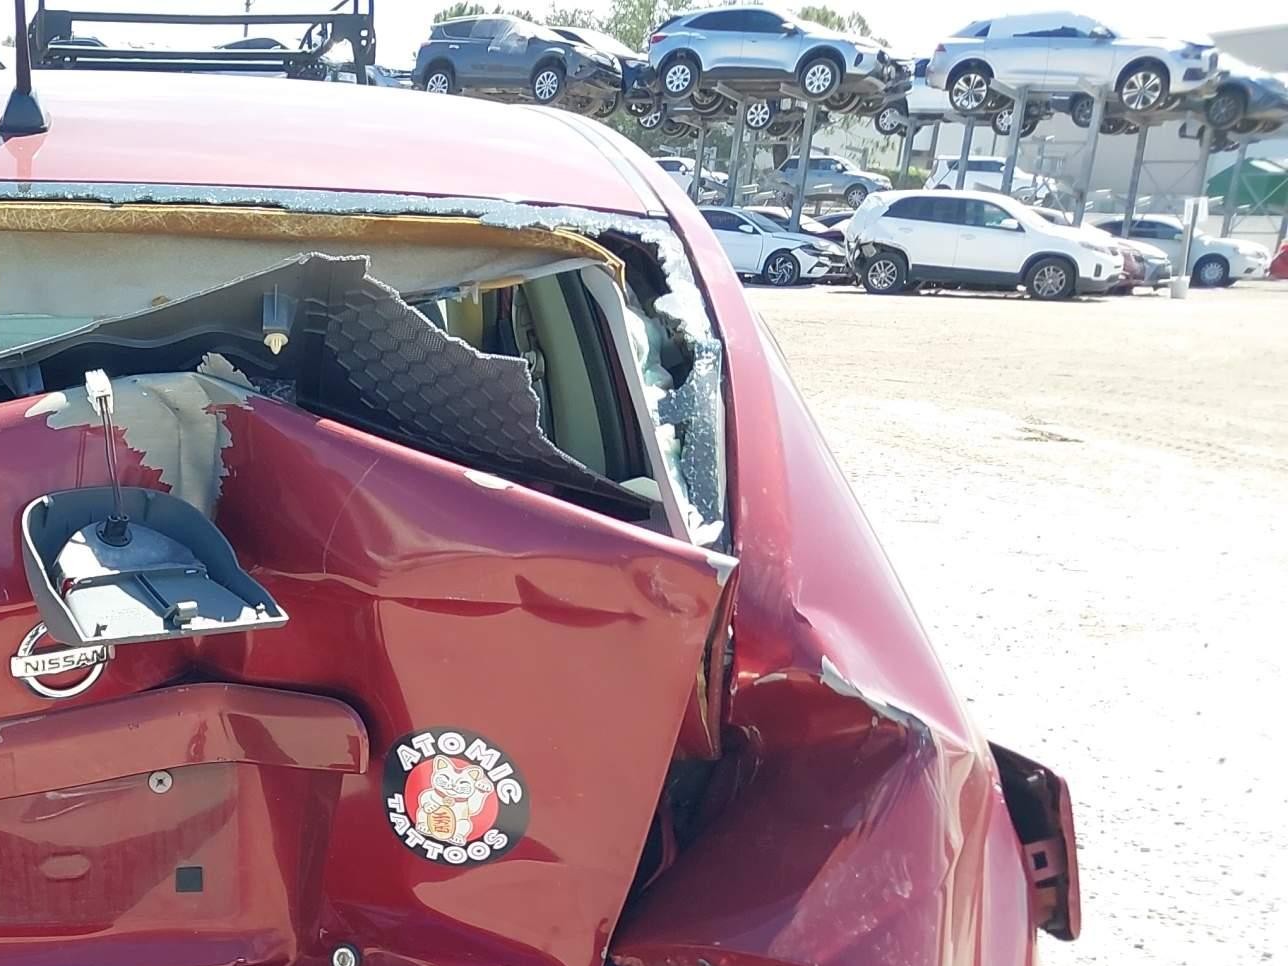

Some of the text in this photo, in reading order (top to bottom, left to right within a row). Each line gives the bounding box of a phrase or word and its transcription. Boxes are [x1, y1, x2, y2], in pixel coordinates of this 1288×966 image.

[24, 645, 107, 674] NISSAN
[396, 732, 523, 805] ATOMIC
[387, 793, 509, 864] TATTOOS
